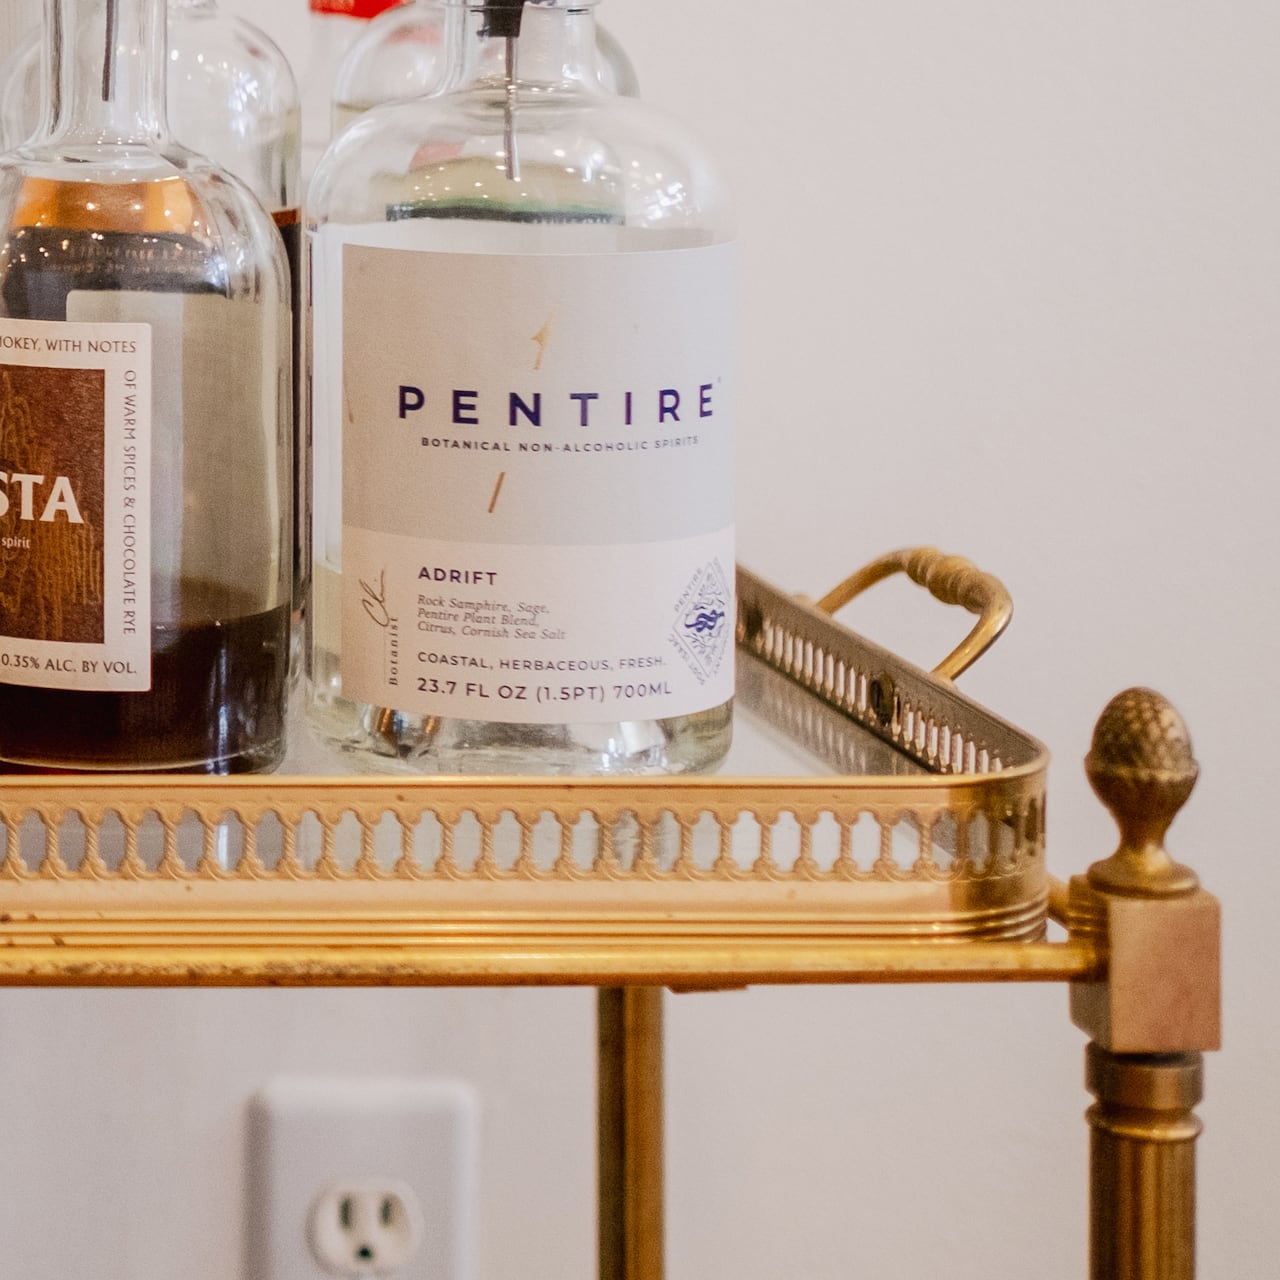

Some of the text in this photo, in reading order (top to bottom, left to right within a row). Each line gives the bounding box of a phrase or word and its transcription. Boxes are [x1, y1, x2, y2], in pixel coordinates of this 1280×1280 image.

[45, 338, 82, 352] WITH
[87, 340, 137, 353] NOTES
[398, 383, 713, 427] PENTIRE
[421, 435, 699, 453] BOTANICAL NON-ALCOHOLIC SPIRITS
[122, 369, 137, 635] OF WARM SPICES & CHOCOLATE RYE
[1, 536, 31, 550] spirit
[418, 566, 498, 586] ADRIFT
[417, 594, 444, 608] Rock
[449, 598, 512, 614] Samphire,
[417, 608, 460, 622] Pentire
[463, 611, 497, 625] Plant
[462, 625, 509, 638] Cornish
[514, 628, 536, 639] Sea
[541, 628, 566, 640] Salt
[388, 617, 399, 686] Botanist
[417, 651, 494, 670] COASTAL,
[499, 658, 614, 672] HERBACEOUS,
[1, 653, 137, 674] 0.35% ALC. BY VOL.
[417, 677, 672, 704] 23.7 FL OZ (1.5PT) 700ML
